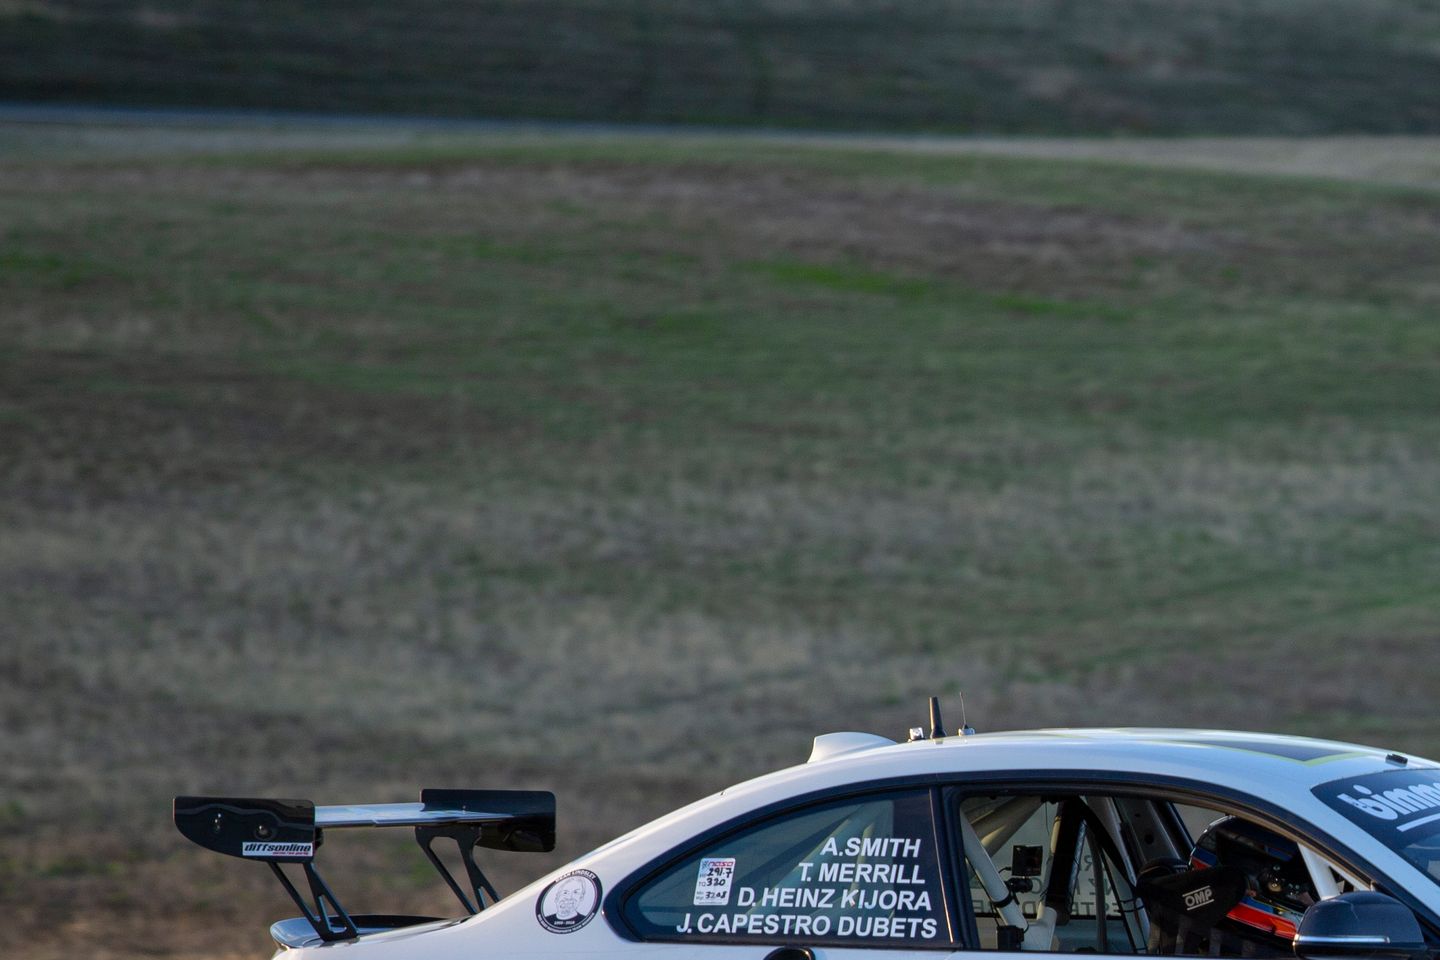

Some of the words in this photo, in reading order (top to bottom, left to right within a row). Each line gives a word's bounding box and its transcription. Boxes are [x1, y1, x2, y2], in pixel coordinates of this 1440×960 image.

[244, 843, 312, 852] diffsonline
[820, 837, 921, 858] A.SMITH
[707, 878, 726, 887] 320
[798, 861, 812, 883] T.
[818, 862, 926, 884] MERRILL
[737, 886, 756, 907] D.
[761, 887, 836, 909] HEINZ
[840, 889, 932, 911] KIJORA
[1184, 888, 1213, 907] OMP
[676, 912, 693, 934] J.
[697, 913, 831, 936] CAPESTRO
[837, 916, 938, 939] DUBETS
